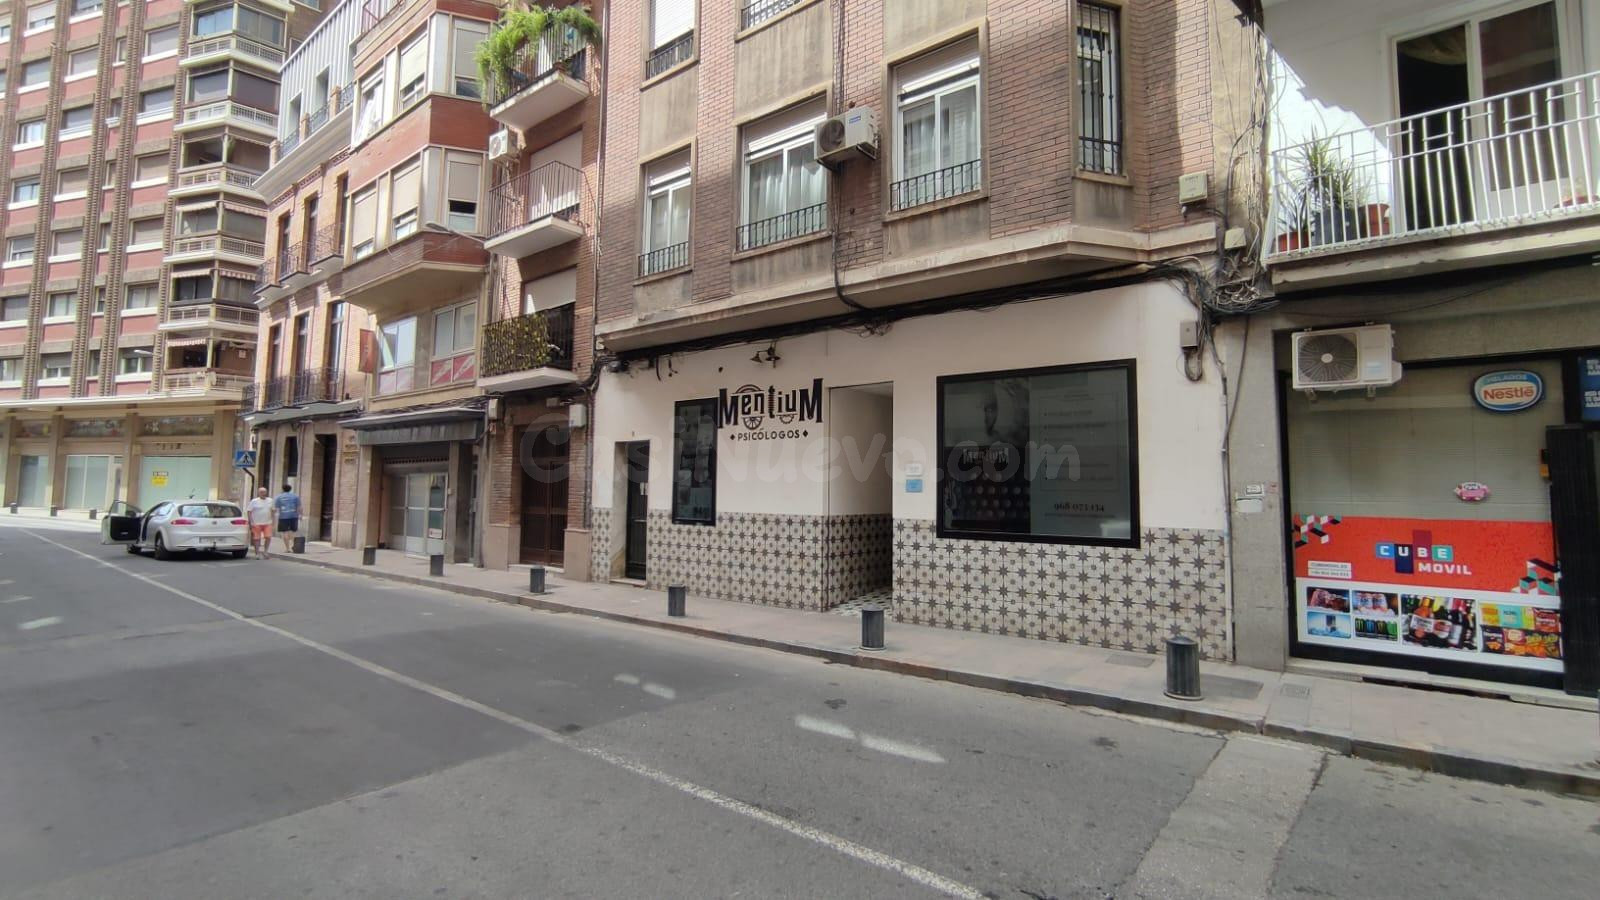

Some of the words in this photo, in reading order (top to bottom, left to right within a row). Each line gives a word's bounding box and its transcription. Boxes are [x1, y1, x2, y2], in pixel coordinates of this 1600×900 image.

[737, 428, 800, 441] PSICÓLOGOS
[1380, 545, 1447, 559] CUBE
[1418, 562, 1472, 575] MOVIL
